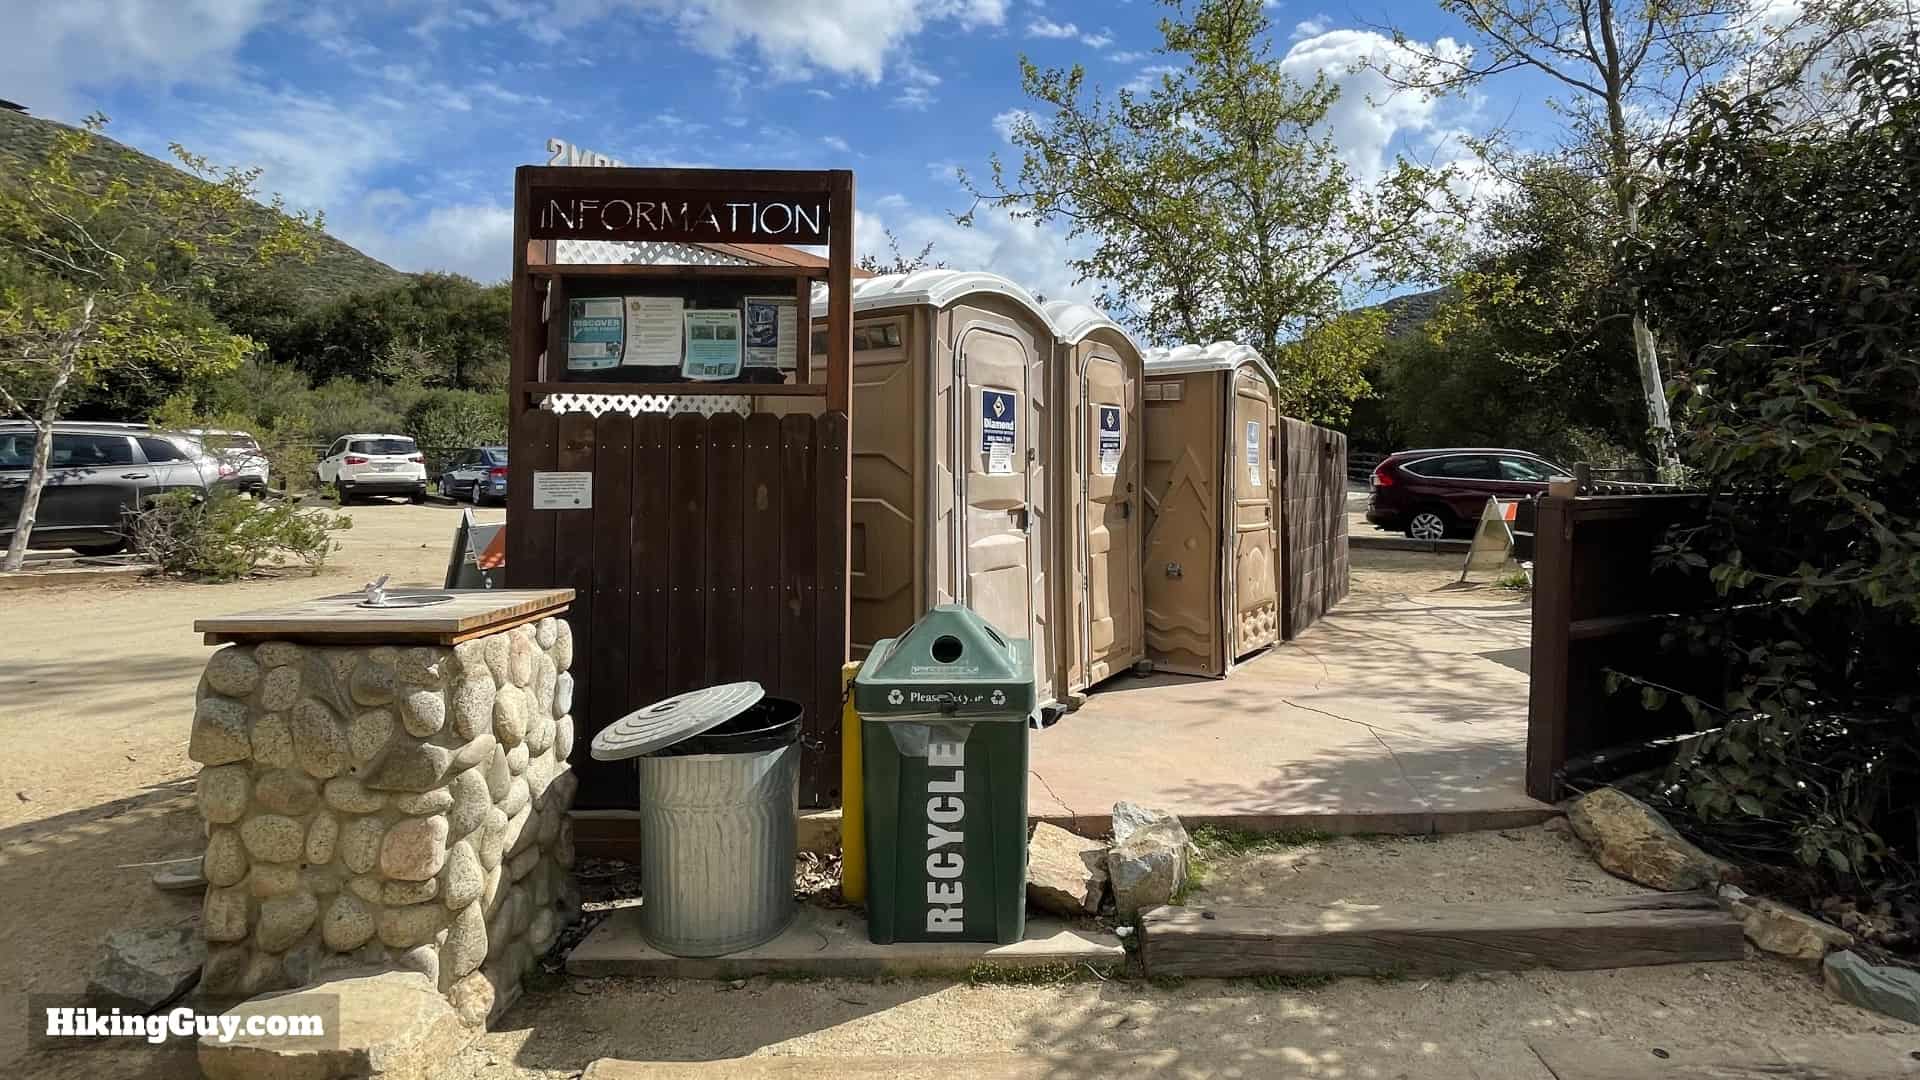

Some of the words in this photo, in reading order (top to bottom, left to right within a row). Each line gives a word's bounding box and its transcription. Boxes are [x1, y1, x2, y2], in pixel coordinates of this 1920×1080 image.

[540, 199, 821, 235] INFORMATION
[984, 418, 1014, 431] Diamond
[926, 742, 965, 933] RECYCLE
